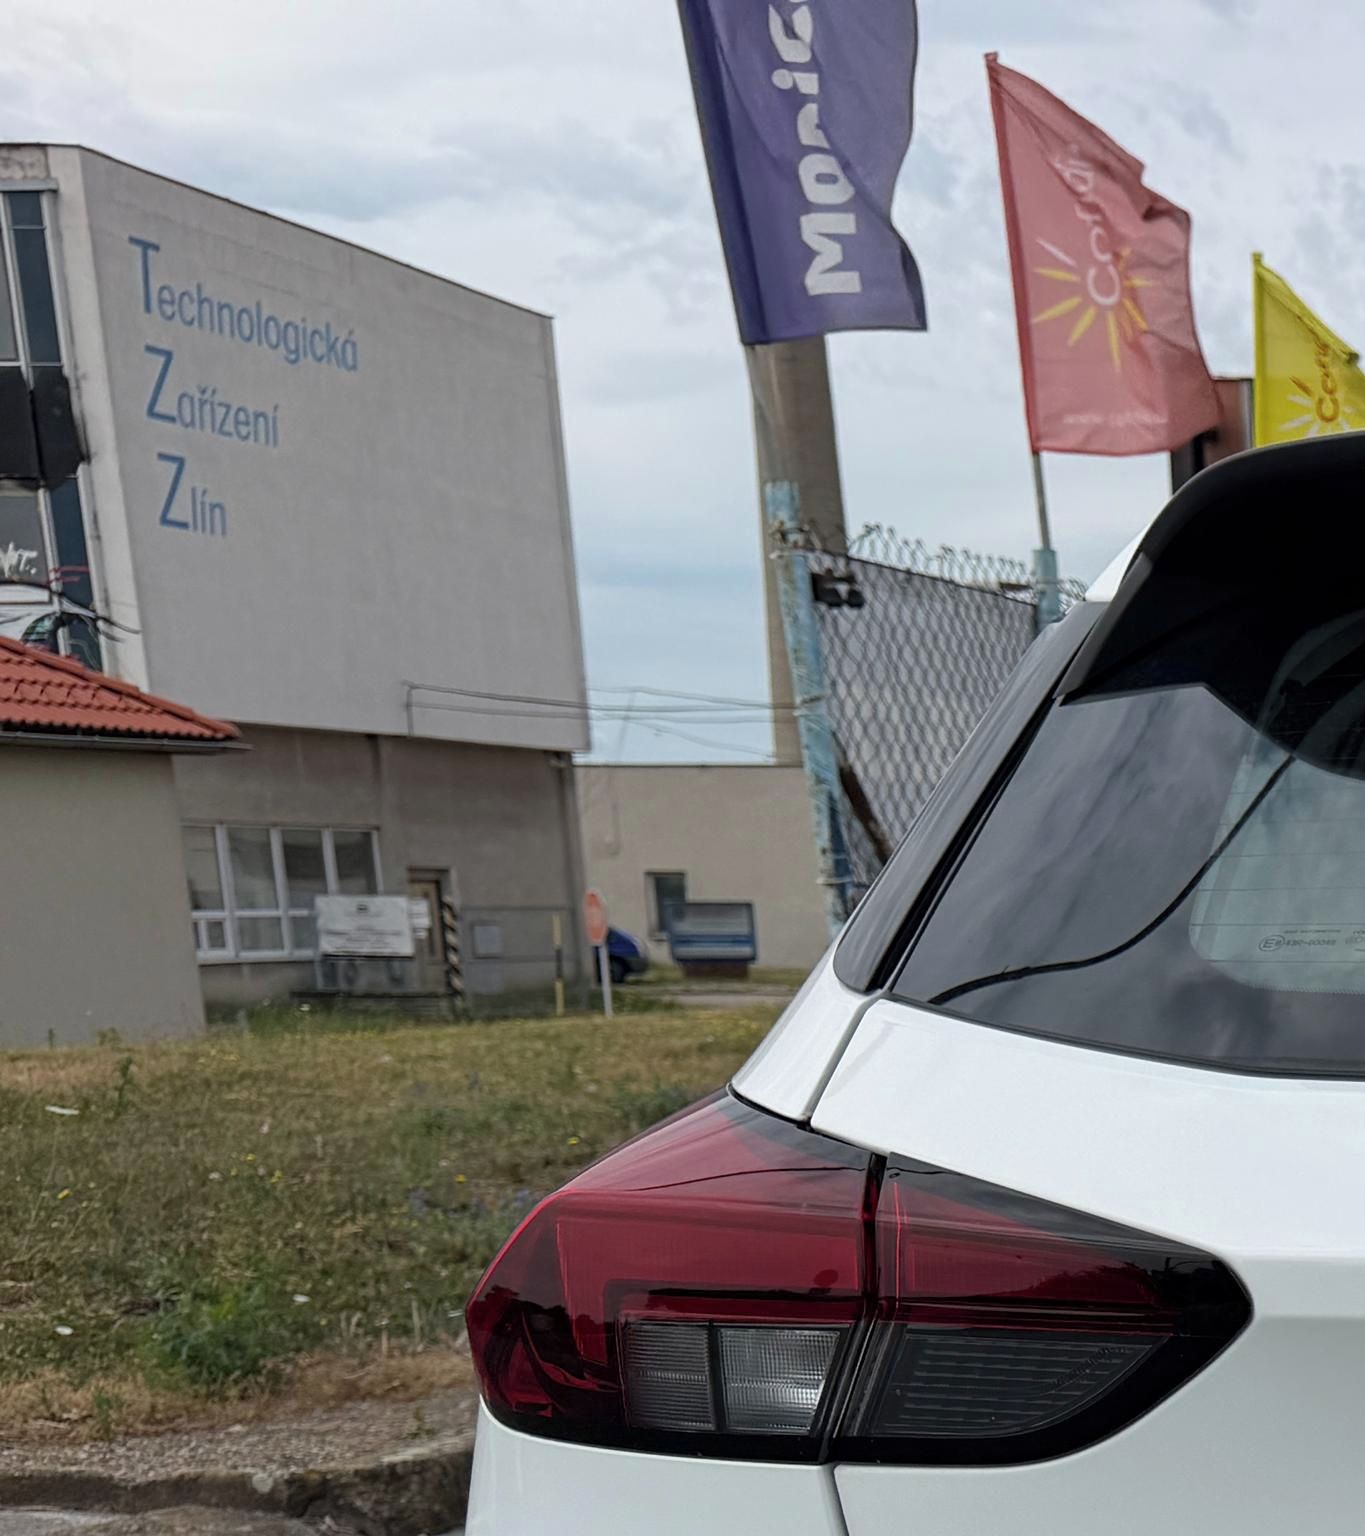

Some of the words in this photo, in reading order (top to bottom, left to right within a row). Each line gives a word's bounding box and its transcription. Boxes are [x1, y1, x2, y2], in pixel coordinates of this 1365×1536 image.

[768, 0, 863, 296] MoniC
[128, 235, 359, 372] Technologická
[144, 343, 279, 449] Zařízení
[157, 452, 227, 537] Zlín
